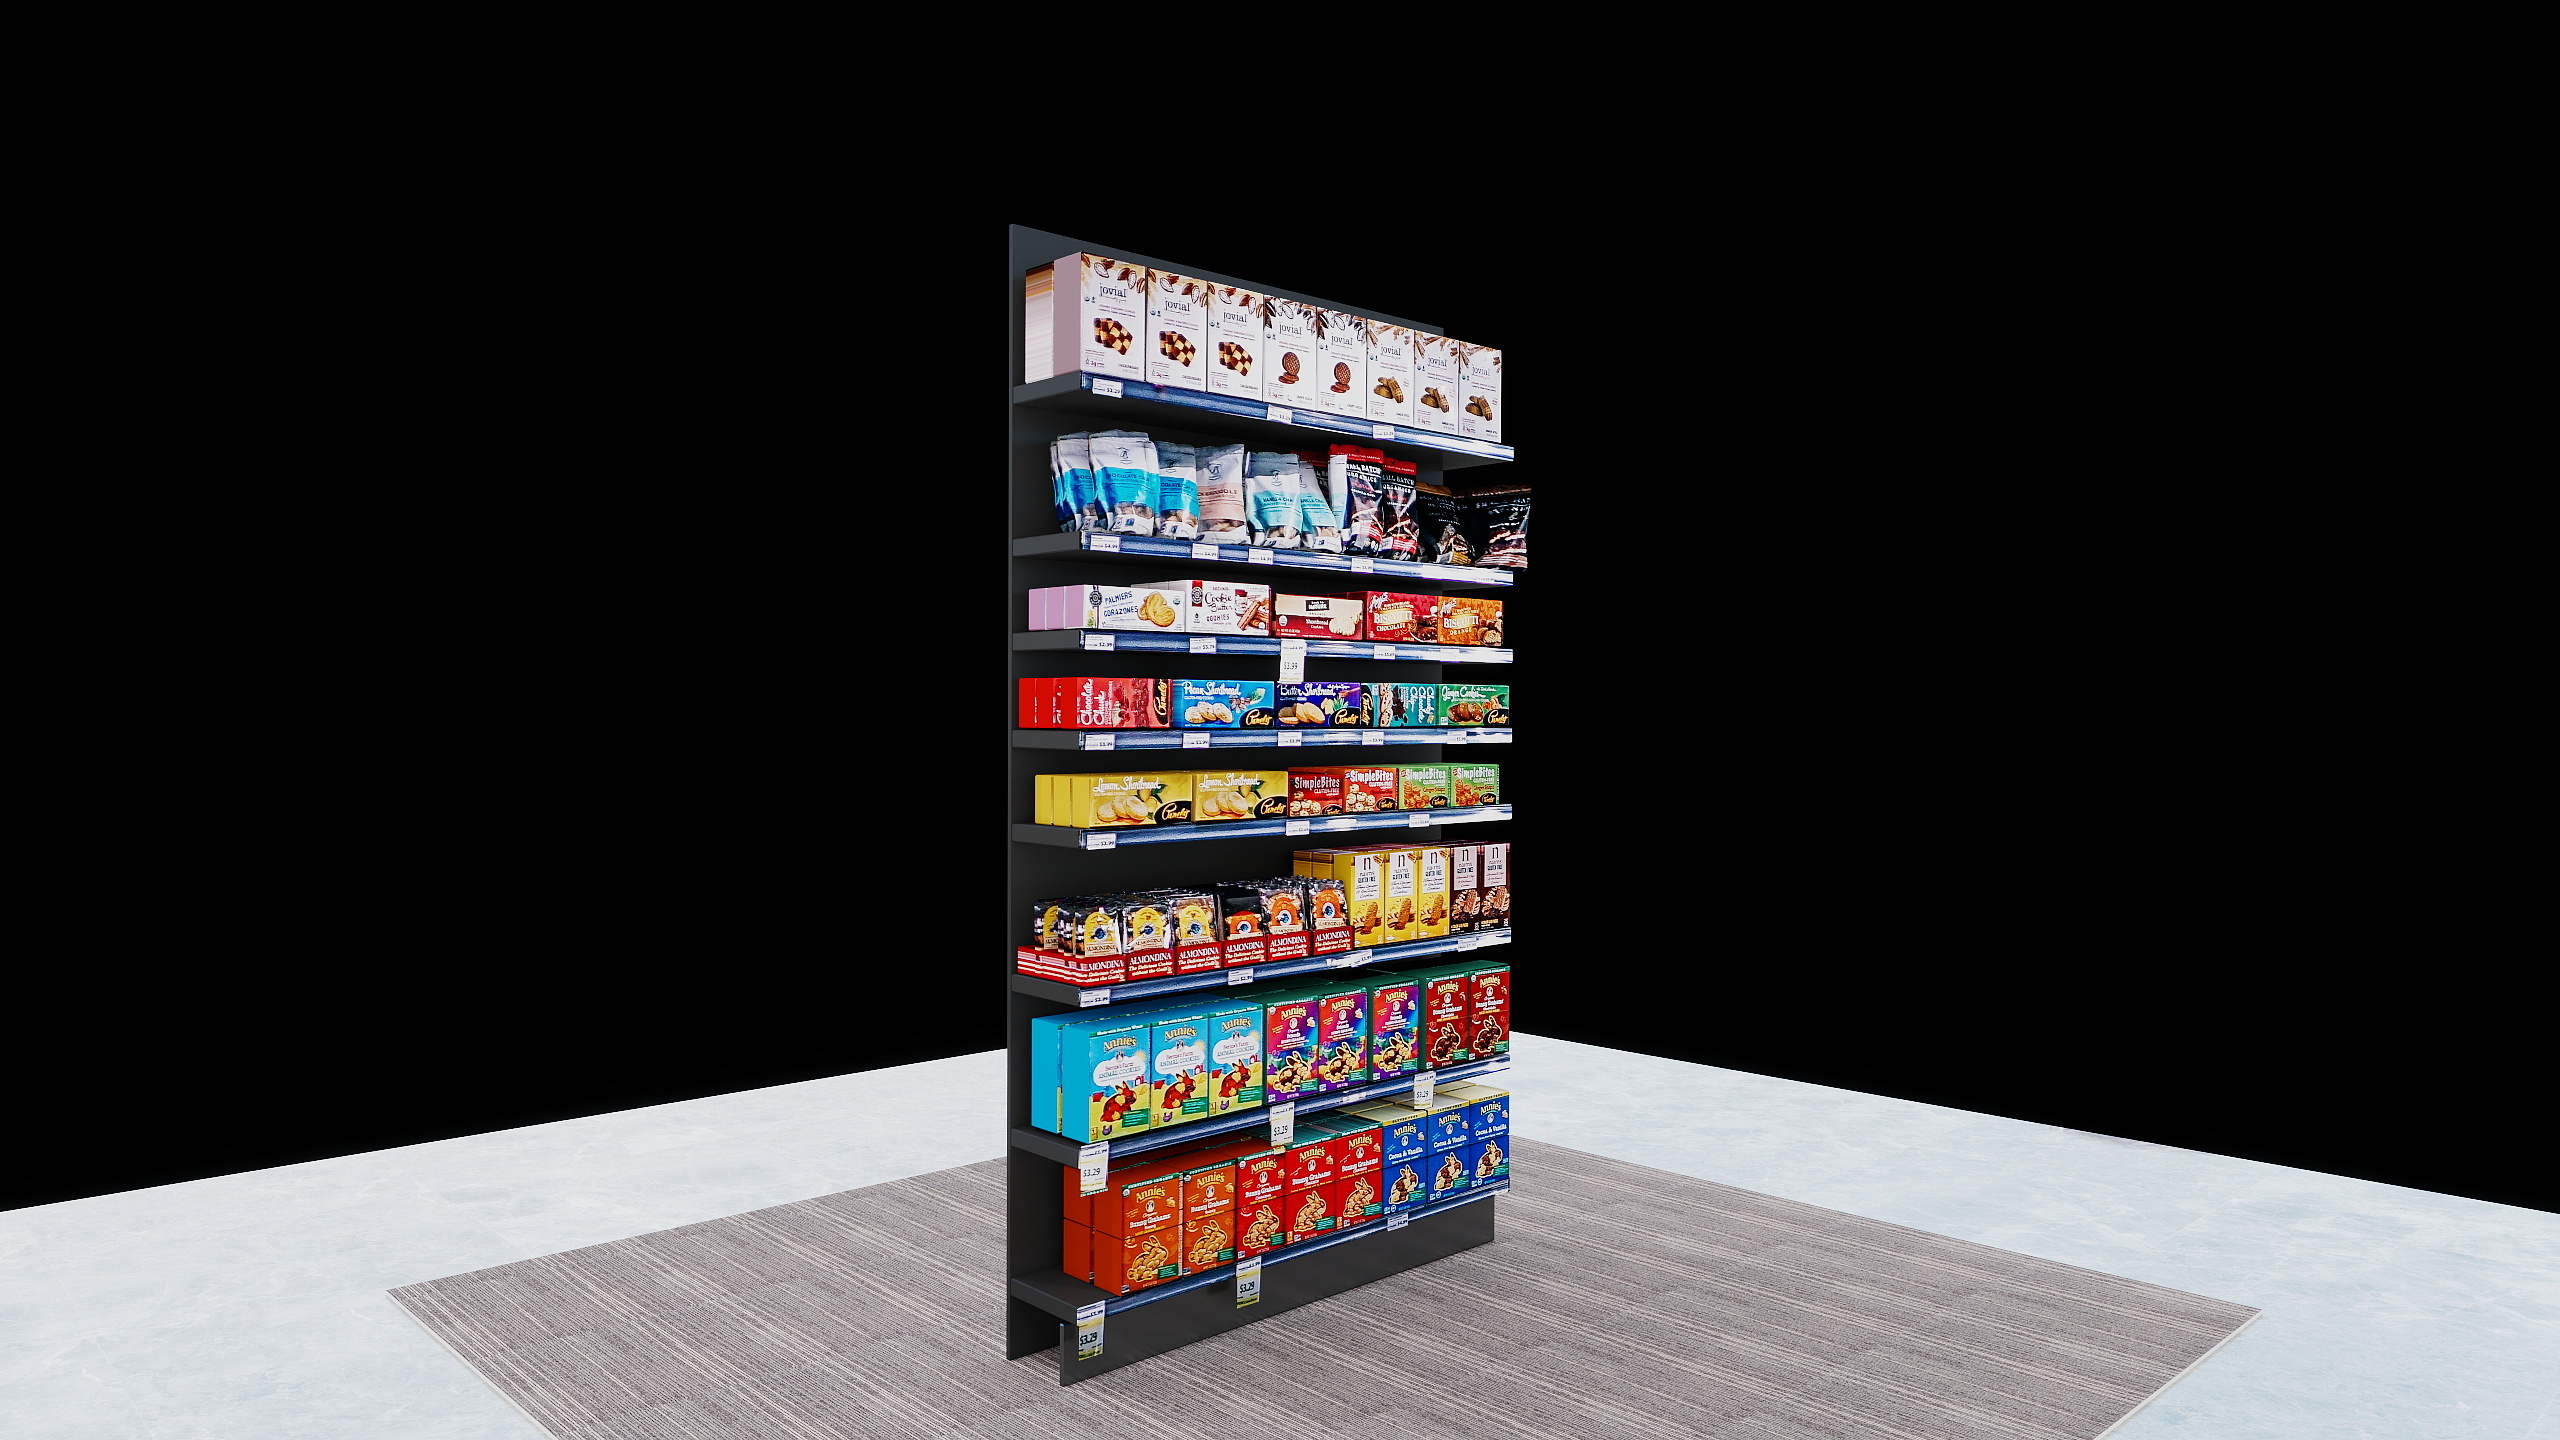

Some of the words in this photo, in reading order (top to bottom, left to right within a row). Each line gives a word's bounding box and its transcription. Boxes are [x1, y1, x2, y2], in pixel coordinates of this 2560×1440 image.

[1099, 283, 1127, 298] jovial
[1164, 297, 1190, 312] jovial
[1223, 309, 1248, 323] jovial
[1279, 321, 1302, 335] jovial
[1331, 333, 1353, 346] jovial
[1380, 344, 1401, 356] jovial
[1427, 354, 1447, 367] jovial
[1472, 365, 1490, 376] jovial
[1104, 591, 1133, 605] PALMIERS
[1205, 592, 1232, 605] Cookie
[1103, 606, 1138, 617] CORAZONES
[1206, 614, 1230, 622] COOKIES
[1374, 611, 1413, 623] BISCOTTI
[1376, 623, 1406, 631] CHOCOLATE
[1443, 616, 1479, 628] BISCOTTI
[1449, 627, 1472, 635] ORANGE
[1204, 681, 1241, 696] Shortbread
[1277, 684, 1301, 696] Butter
[1302, 683, 1336, 696] Shortbread
[1442, 686, 1460, 702] Ginger
[1199, 774, 1224, 788] Lemon
[1224, 773, 1260, 786] Shortbread
[1349, 770, 1394, 784] SimpleBites
[1405, 768, 1446, 781] SimpleBites
[1457, 767, 1495, 780] SimpleBites
[1092, 778, 1120, 792] Lemon
[1120, 776, 1161, 790] Shortbread
[1294, 776, 1340, 790] SimpleBites
[1430, 851, 1437, 864] n
[1462, 849, 1469, 861] n
[1492, 847, 1499, 859] n
[1363, 857, 1371, 870] n
[1397, 854, 1405, 867] n
[1270, 936, 1306, 947] ALMONDINA
[1315, 930, 1350, 941] ALMONDINA
[1179, 947, 1219, 959] ALMONDINA
[1226, 941, 1264, 953] ALMONDINA
[1129, 953, 1172, 965] ALMONDINA
[1438, 981, 1459, 995] Annie's
[1480, 975, 1500, 988] Annie's
[1385, 989, 1408, 1003] Annie's
[1331, 997, 1355, 1012] Annie's
[1281, 1005, 1307, 1020] Annie's
[1222, 1015, 1251, 1032] Annie's
[1165, 1024, 1197, 1041] Annie's
[1104, 1032, 1137, 1052] Annie's
[1099, 1071, 1118, 1079] ANIMAL
[1118, 1066, 1141, 1074] COOKIES
[1480, 1101, 1501, 1116] Annie's
[1438, 1112, 1461, 1127] Annie's
[1274, 1125, 1288, 1136] $3.29
[1393, 1123, 1417, 1138] Annie's
[1492, 1123, 1507, 1132] Vanilla
[1348, 1134, 1373, 1150] Annie's
[1433, 1140, 1447, 1148] Cocoa
[1451, 1135, 1467, 1144] Vanilla
[1299, 1146, 1325, 1162] Annie's
[1388, 1151, 1402, 1161] Cocoa
[1407, 1146, 1423, 1156] Vanilla
[1251, 1157, 1277, 1174] Annie's
[1341, 1164, 1357, 1172] Bunny
[1357, 1158, 1379, 1167] Grahams
[1083, 1168, 1100, 1177] $3.29
[1196, 1171, 1225, 1188] Annie's
[1292, 1177, 1309, 1185] Bunny
[1309, 1171, 1331, 1180] Grahams
[1136, 1185, 1165, 1203] Annie's
[1245, 1190, 1260, 1198] Bunny
[1260, 1184, 1282, 1194] Grahams
[1190, 1204, 1207, 1213] Bunny
[1208, 1199, 1230, 1208] Grahams
[1129, 1220, 1148, 1228] Bunny
[1148, 1213, 1171, 1223] Grahams
[1080, 1332, 1097, 1346] $3.29
